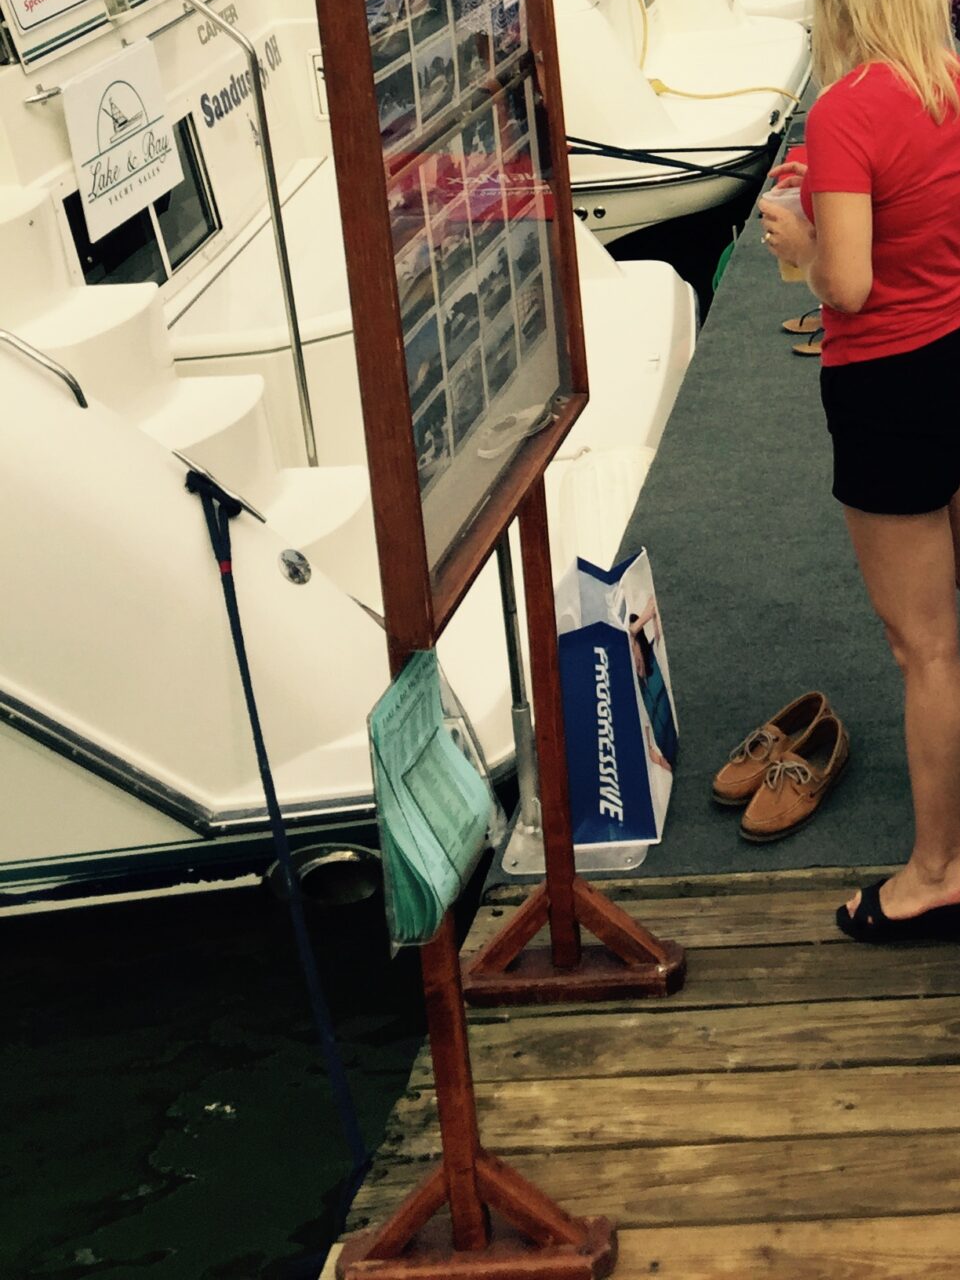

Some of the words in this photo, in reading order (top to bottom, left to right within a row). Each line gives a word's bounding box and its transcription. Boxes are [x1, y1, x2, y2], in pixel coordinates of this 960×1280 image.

[264, 34, 283, 71] OH
[88, 156, 120, 199] Lake
[127, 150, 138, 172] &
[142, 130, 168, 164] Bay
[593, 646, 624, 823] PROGRESSIVE
